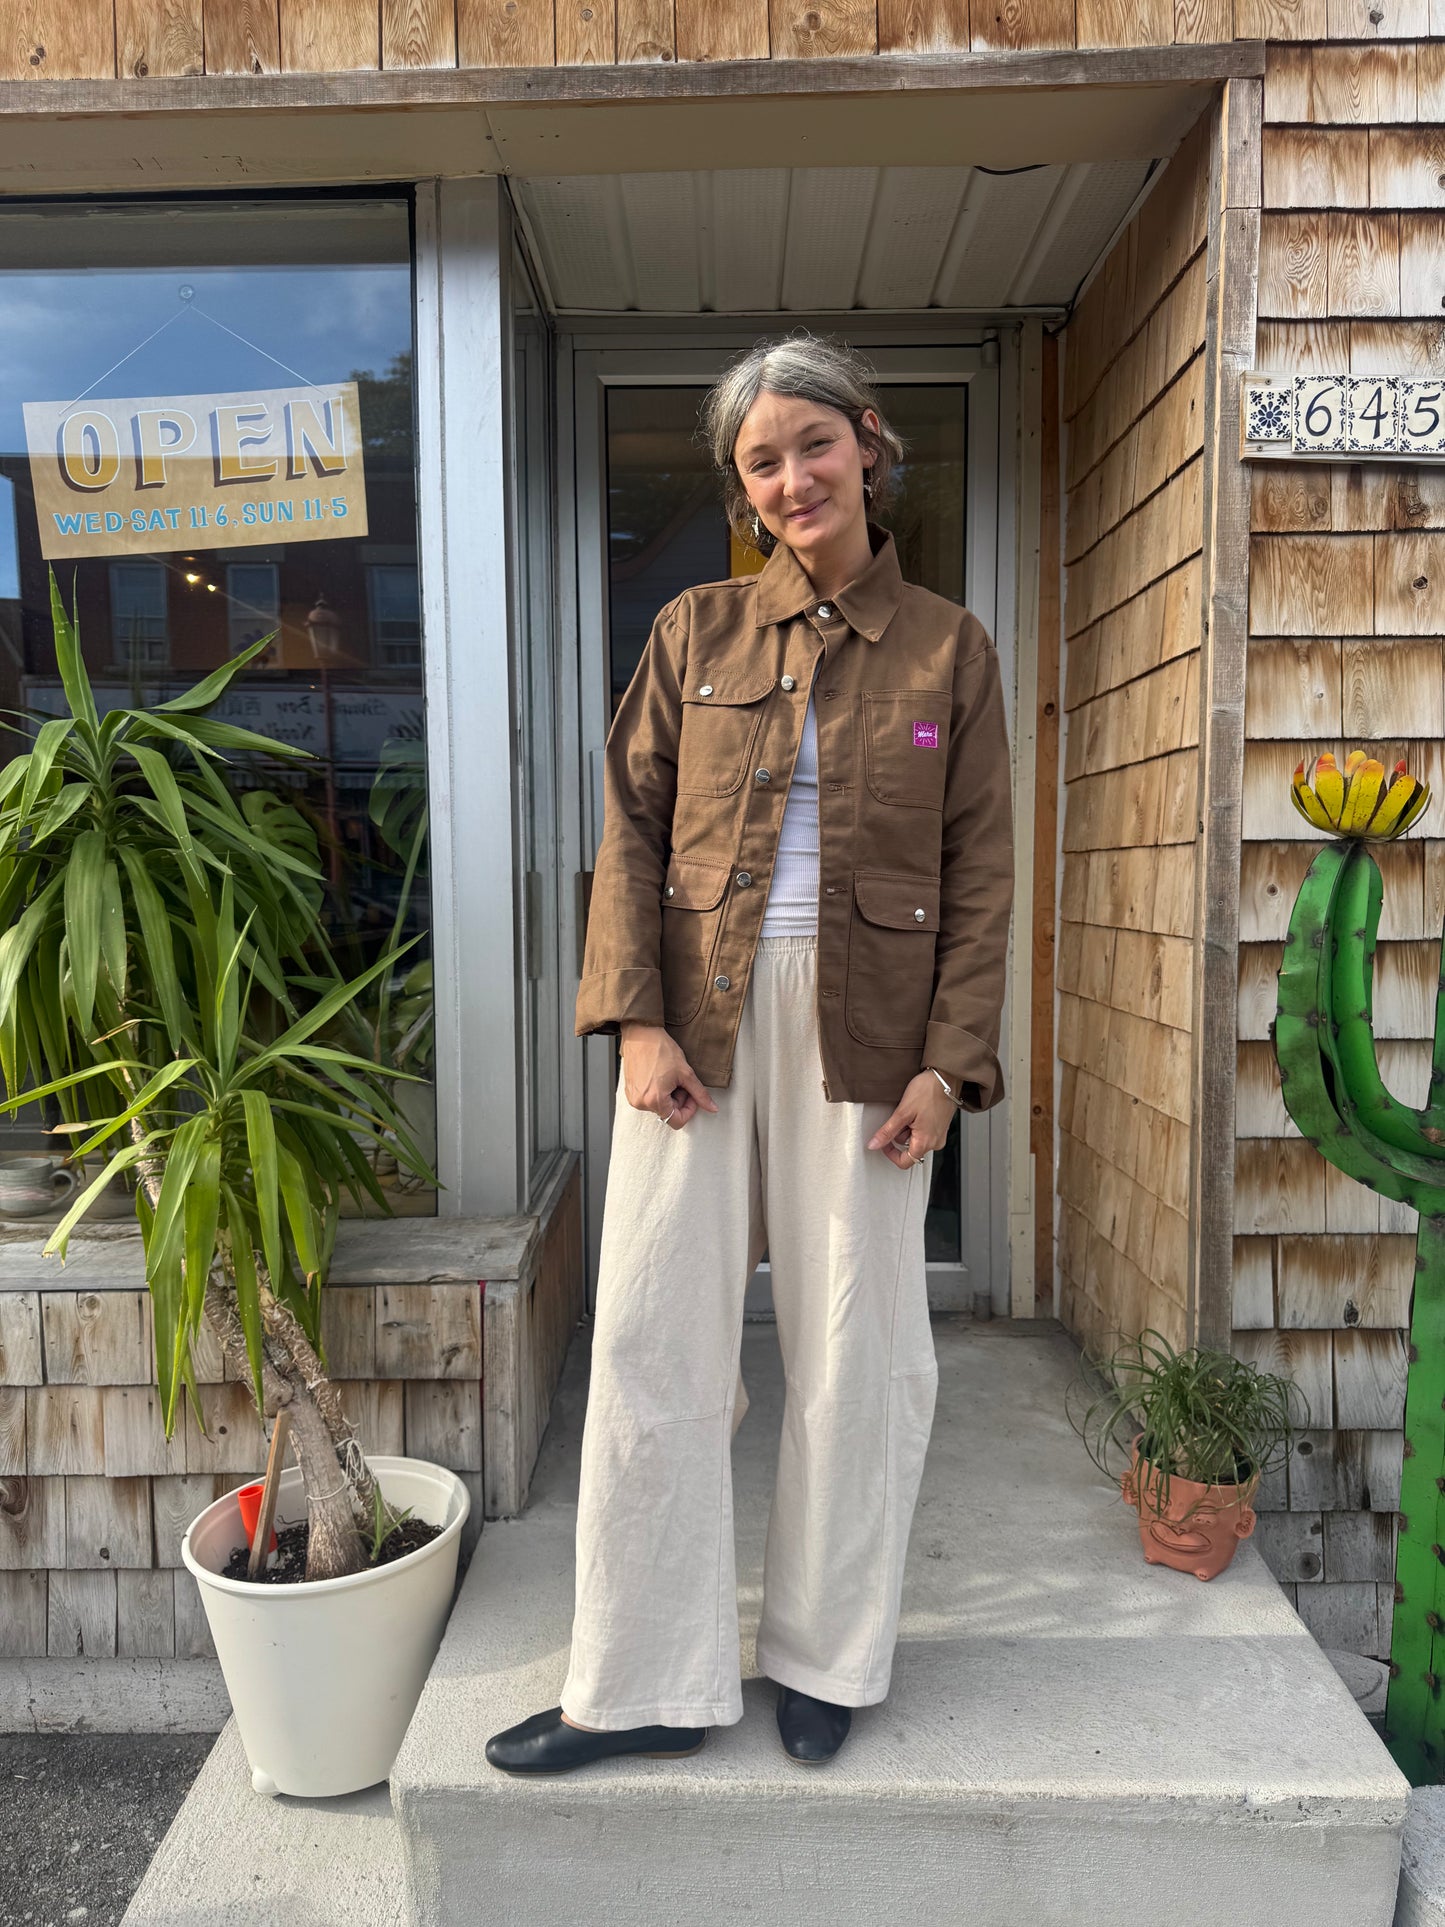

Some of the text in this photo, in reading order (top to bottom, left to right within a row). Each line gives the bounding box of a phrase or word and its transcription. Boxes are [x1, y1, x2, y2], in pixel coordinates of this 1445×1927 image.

[1305, 386, 1441, 440] 645
[57, 396, 348, 493] OPEN
[242, 500, 294, 526] SUN
